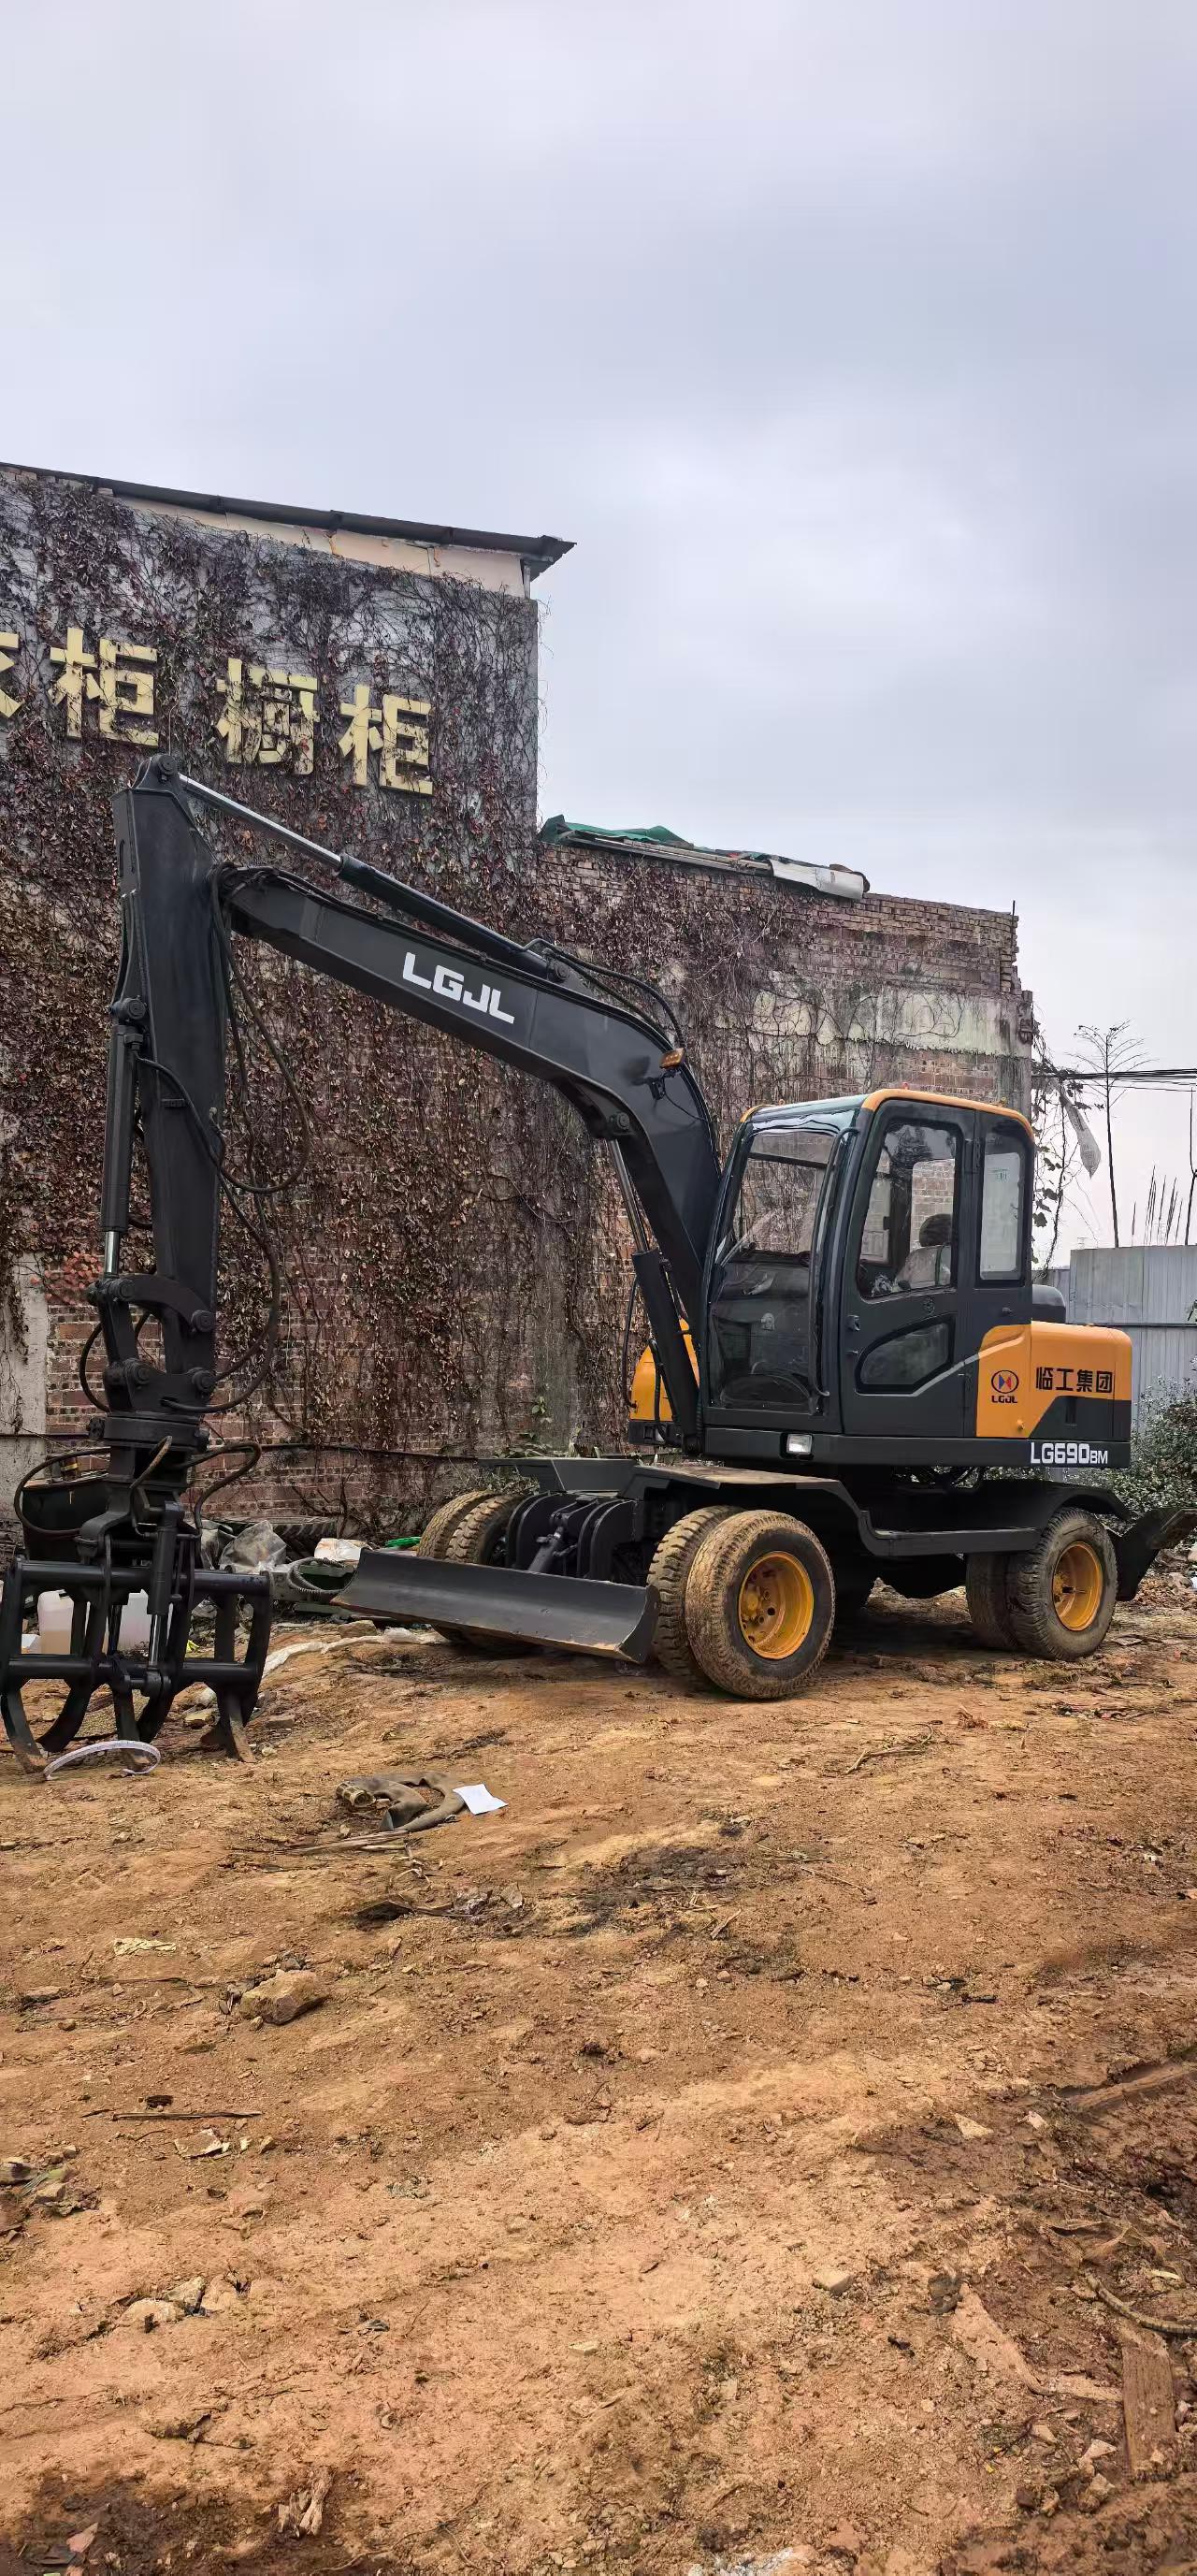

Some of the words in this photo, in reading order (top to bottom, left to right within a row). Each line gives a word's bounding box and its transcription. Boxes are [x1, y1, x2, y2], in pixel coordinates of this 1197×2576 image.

[216, 658, 433, 795] 橱柜
[402, 951, 515, 1024] LGJL
[991, 1395, 1018, 1404] LGJL
[1035, 1367, 1113, 1394] 临工集团
